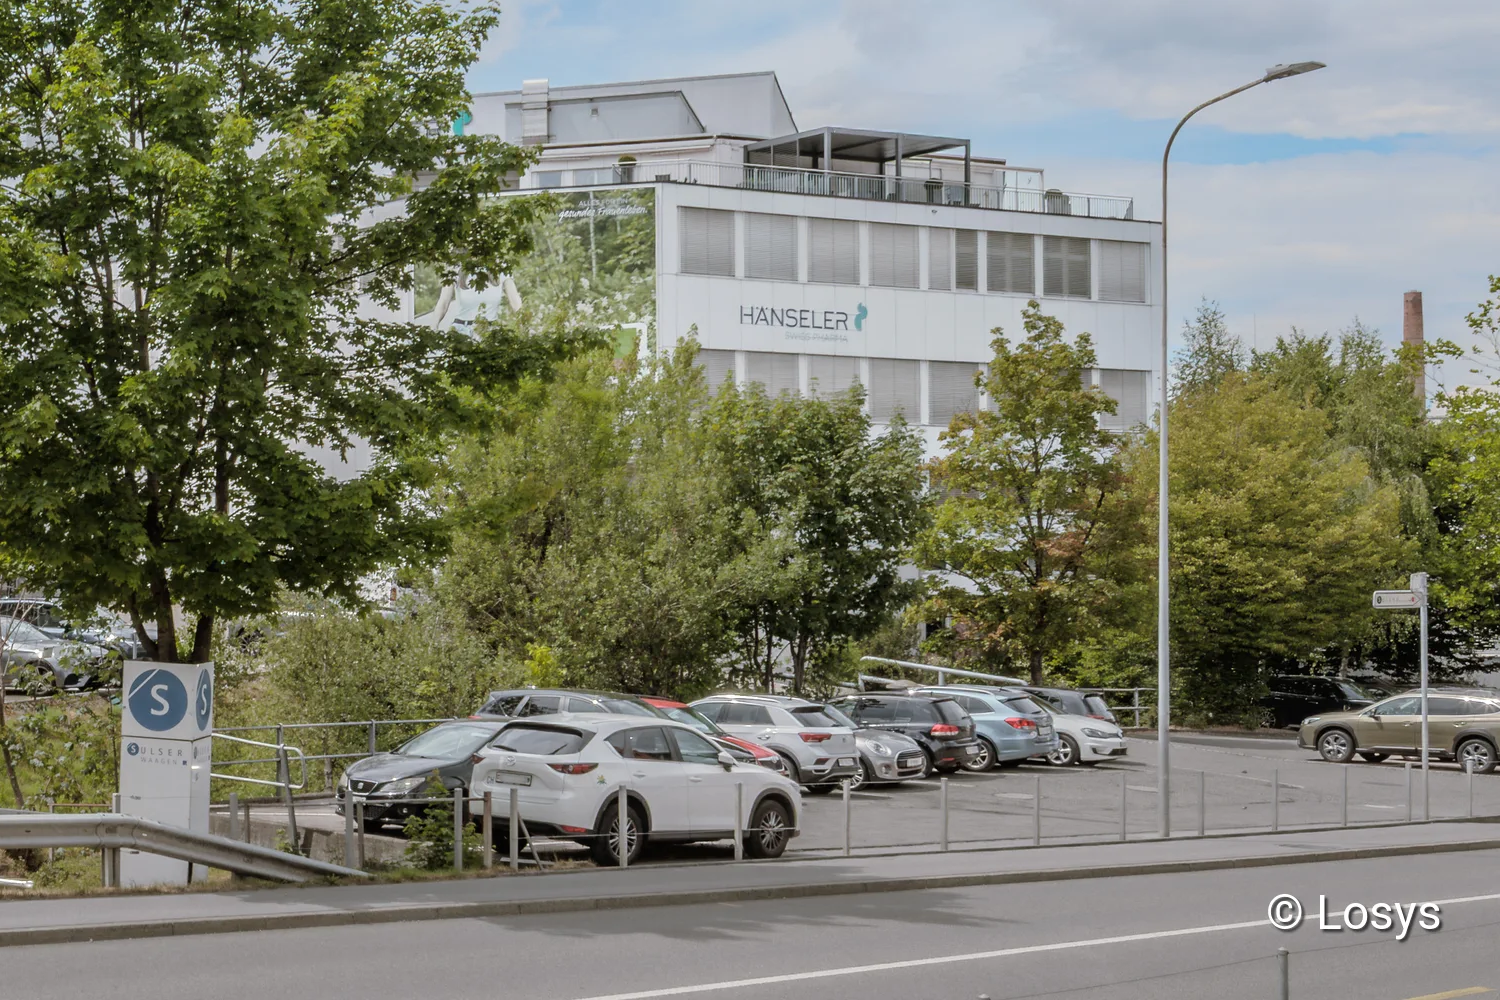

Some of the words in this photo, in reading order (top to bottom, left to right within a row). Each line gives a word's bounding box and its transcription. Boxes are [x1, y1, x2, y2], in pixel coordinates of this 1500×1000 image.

[740, 305, 848, 330] HÄNSELER
[150, 684, 170, 716] S
[200, 684, 207, 716] S
[128, 743, 183, 756] SULSER
[140, 756, 178, 766] WAAGEN
